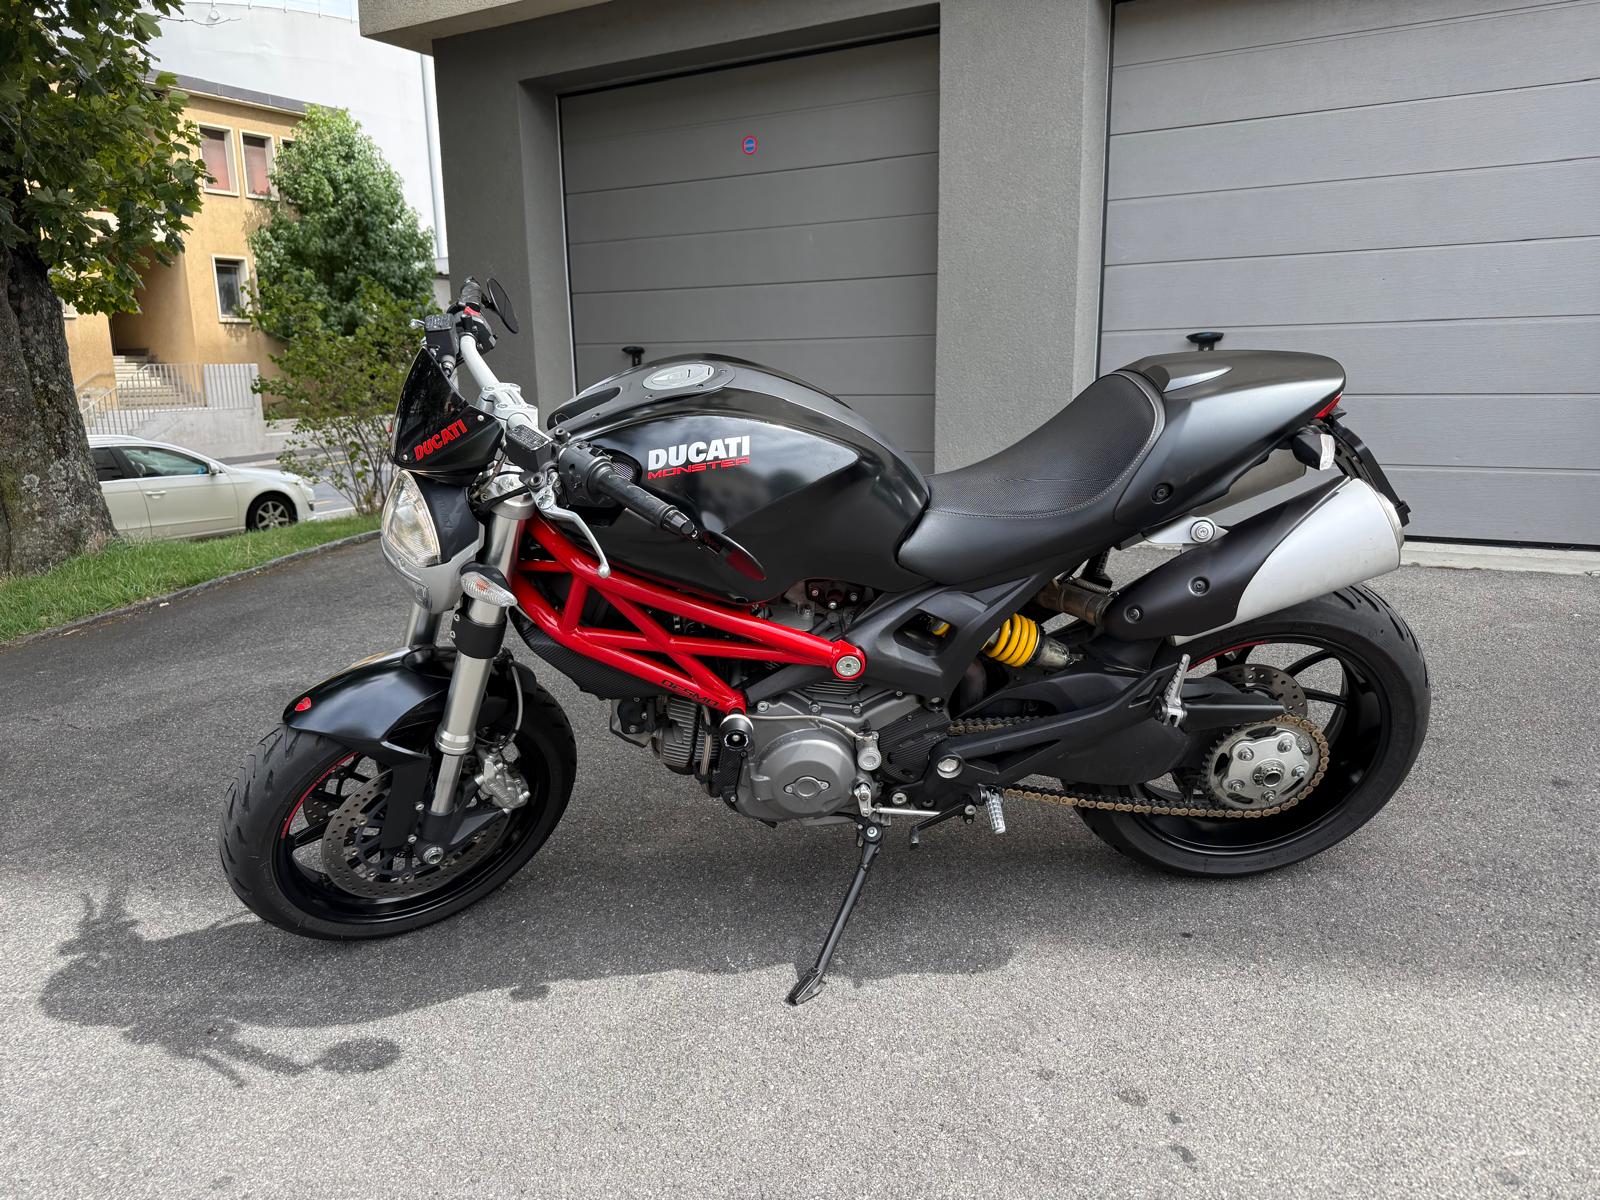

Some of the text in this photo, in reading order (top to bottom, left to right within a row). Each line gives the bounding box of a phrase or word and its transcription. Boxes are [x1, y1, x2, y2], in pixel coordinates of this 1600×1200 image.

[413, 418, 468, 461] DUCATI
[648, 435, 750, 471] DUCATI
[648, 456, 750, 480] MONSTER
